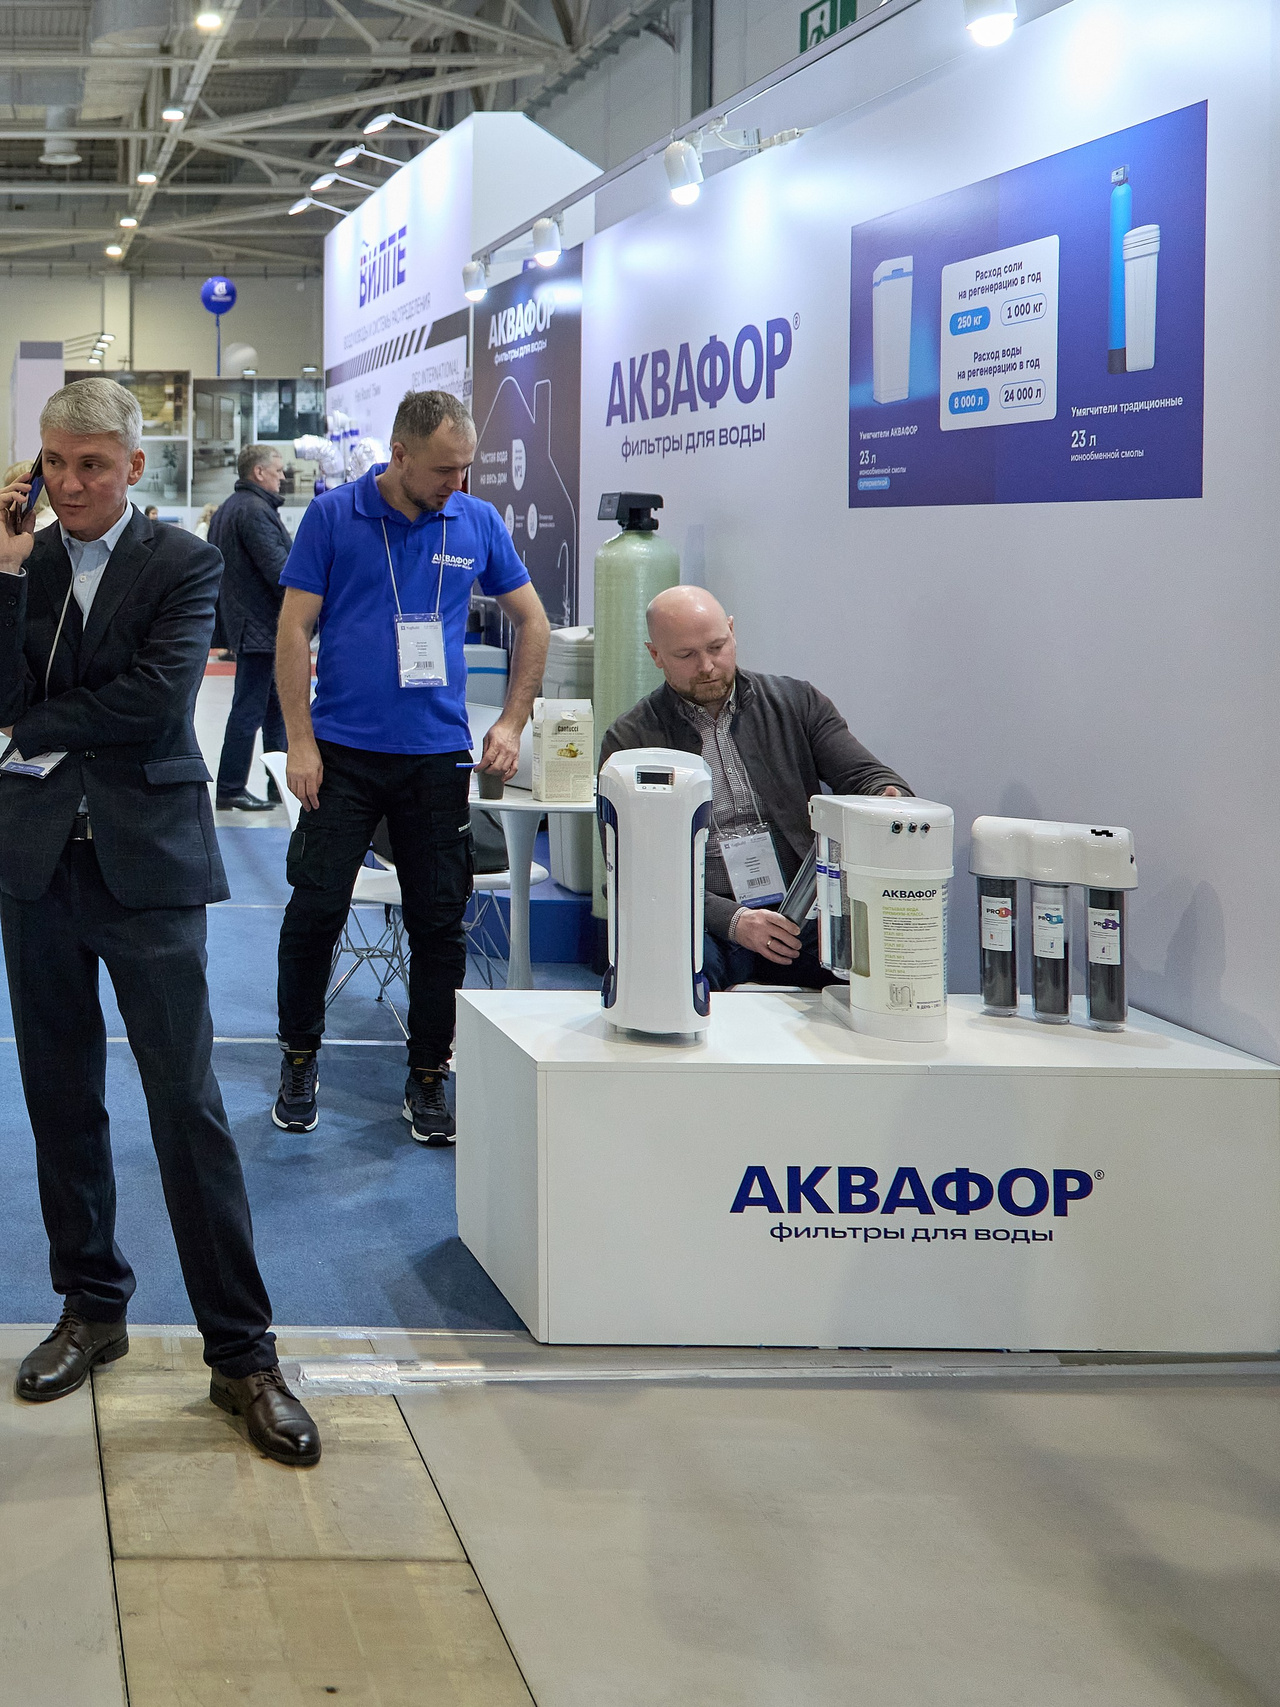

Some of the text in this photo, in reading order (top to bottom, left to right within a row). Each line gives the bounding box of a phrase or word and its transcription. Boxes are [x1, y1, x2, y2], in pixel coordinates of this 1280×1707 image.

[975, 261, 1023, 282] Расход соли
[958, 271, 1042, 301] на регенерацию в год
[1033, 302, 1043, 313] кг
[488, 294, 557, 350] АКВАФОР
[957, 314, 983, 329] 250 кг
[973, 346, 1022, 363] Расход воды
[957, 357, 1040, 381] на регенерацию в год
[977, 396, 983, 406] л
[1035, 388, 1042, 399] л
[1071, 396, 1184, 417] Умягчители традиционные
[859, 424, 919, 441] Умягчители АКВАФОР
[1071, 429, 1097, 448] 23 л
[621, 422, 766, 463] фильтры для воды
[859, 449, 877, 465] 23 л
[1070, 448, 1145, 462] ионообменной смолы
[882, 889, 938, 898] АКВАФОР
[986, 908, 1000, 916] PRO
[769, 1222, 1054, 1244] фильтры для воды
